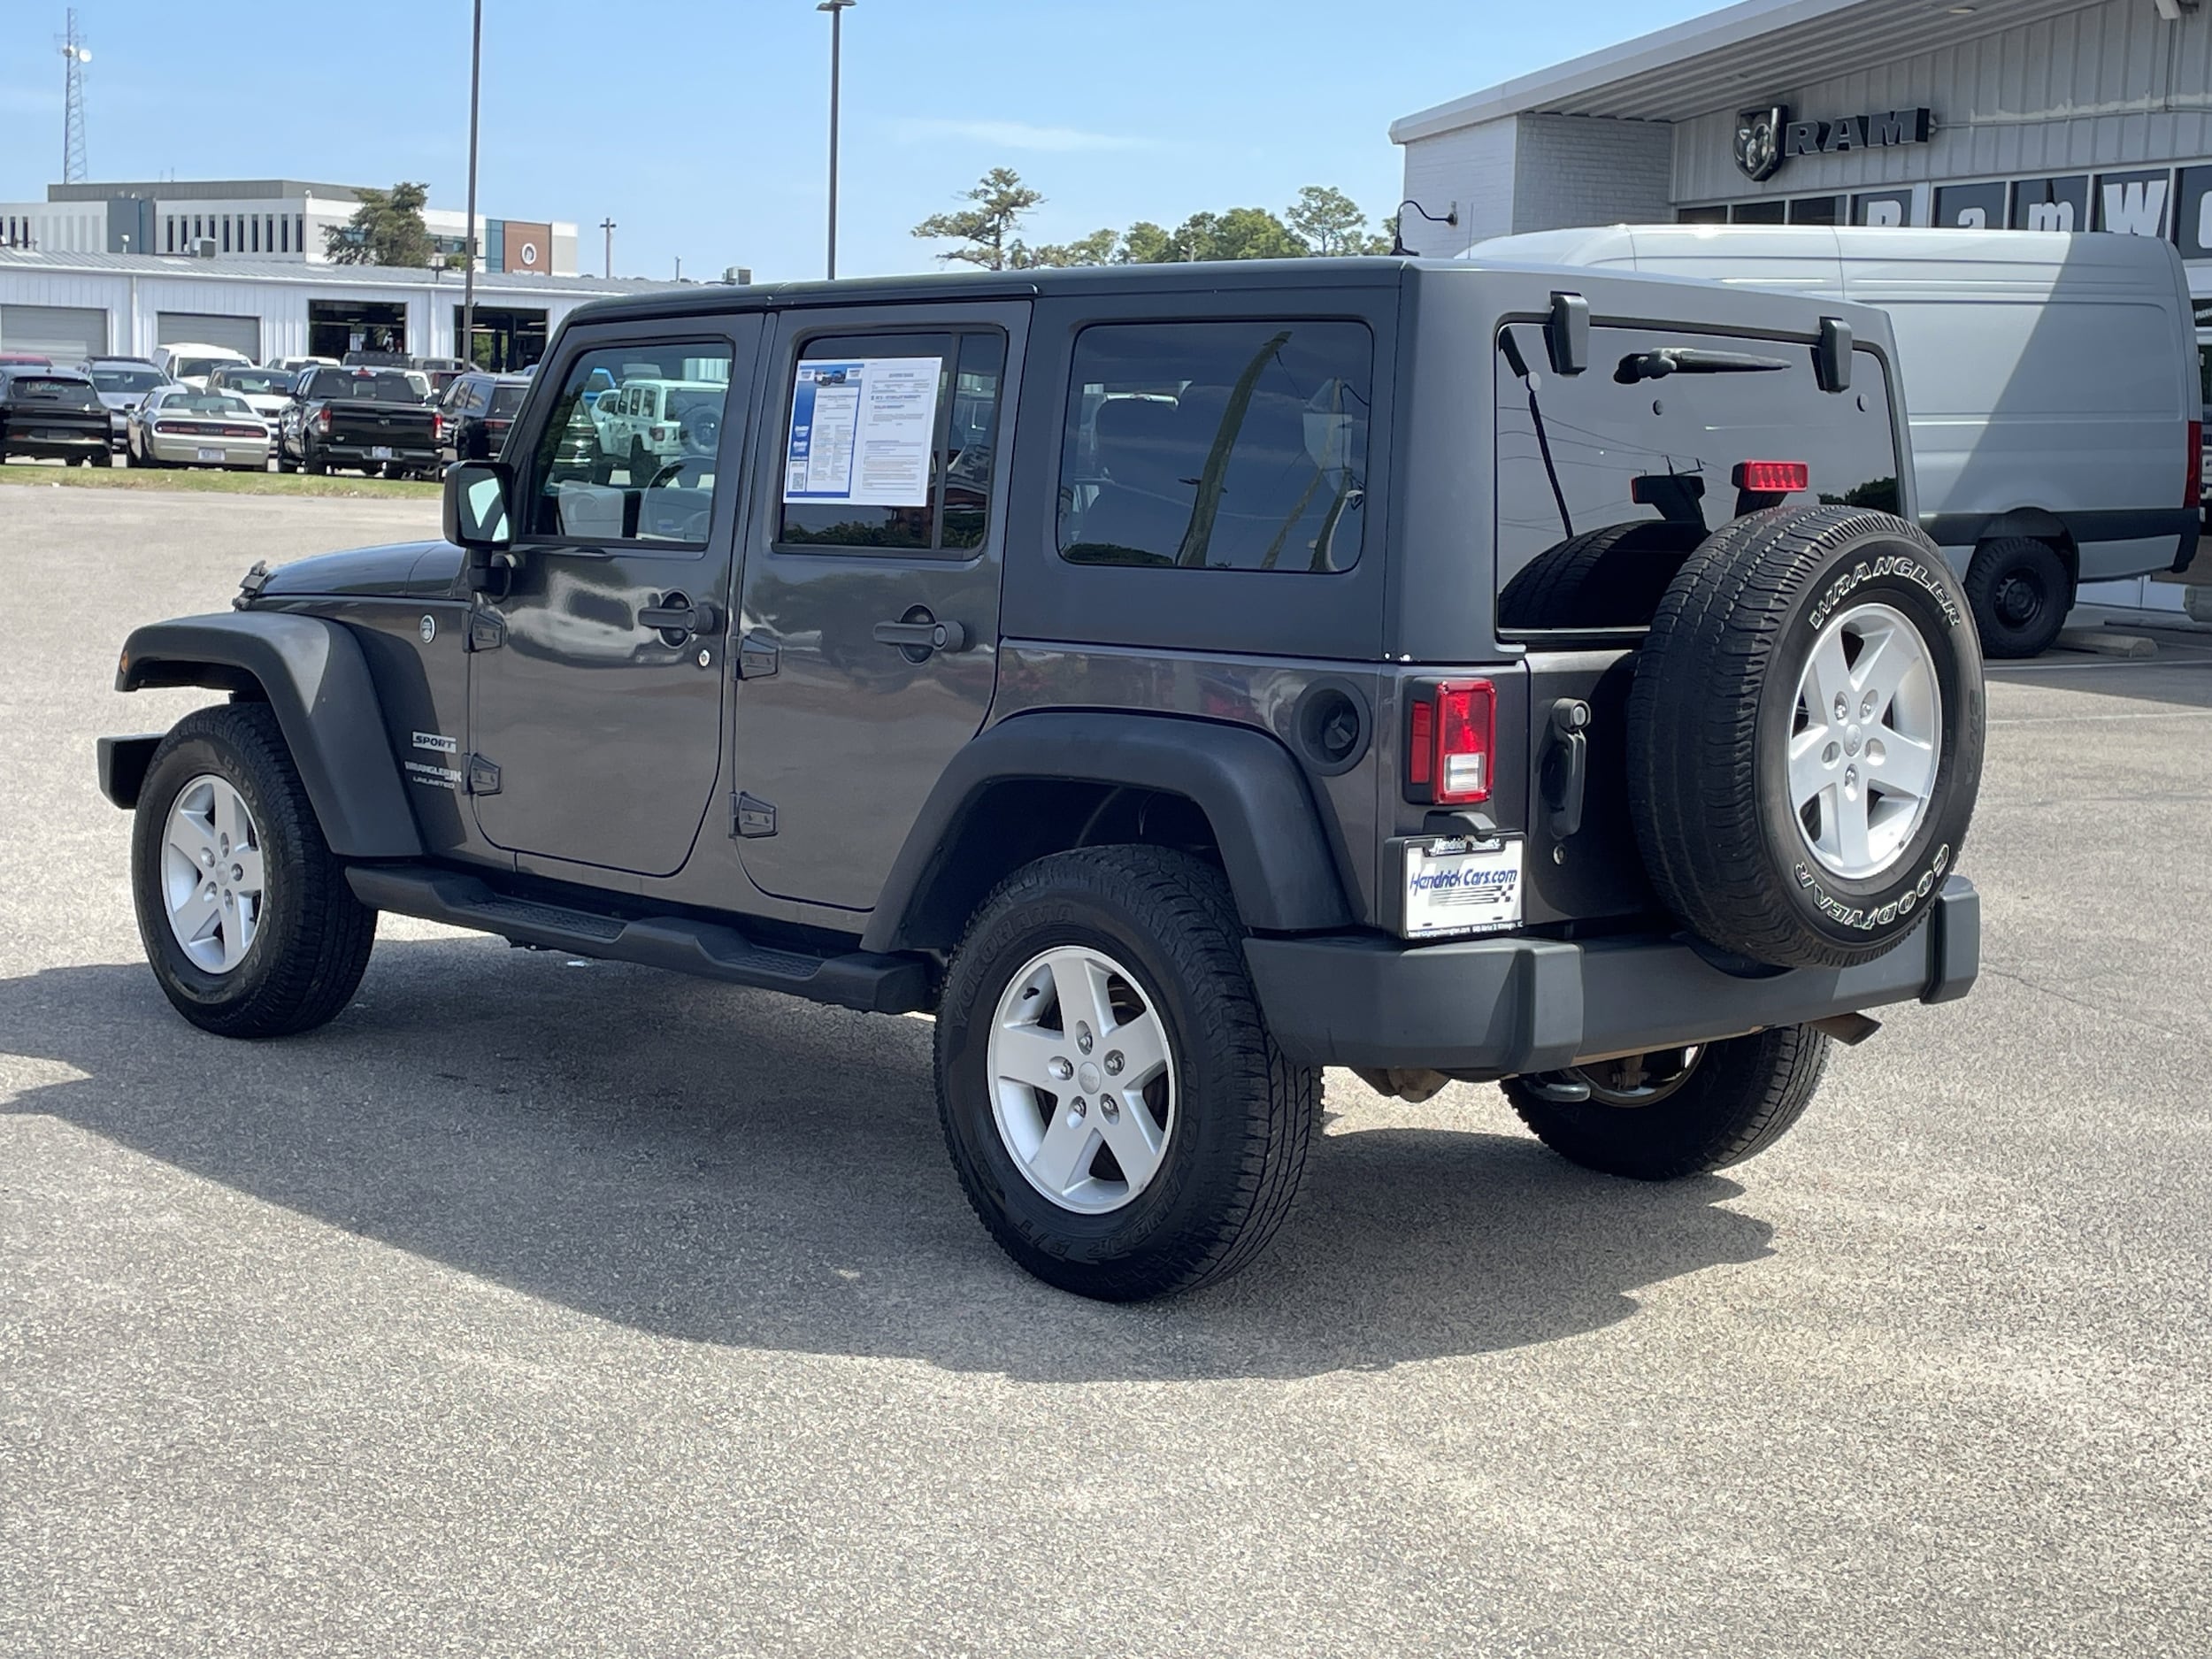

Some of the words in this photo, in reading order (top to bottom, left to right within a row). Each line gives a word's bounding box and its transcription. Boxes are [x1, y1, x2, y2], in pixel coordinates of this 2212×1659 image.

[1786, 107, 1930, 157] RAM
[1809, 556, 1961, 632] WRANGLER
[416, 736, 452, 749] SPORT
[1794, 842, 1950, 931] GOODYEAR
[950, 903, 1076, 1027] YOKOHAMA
